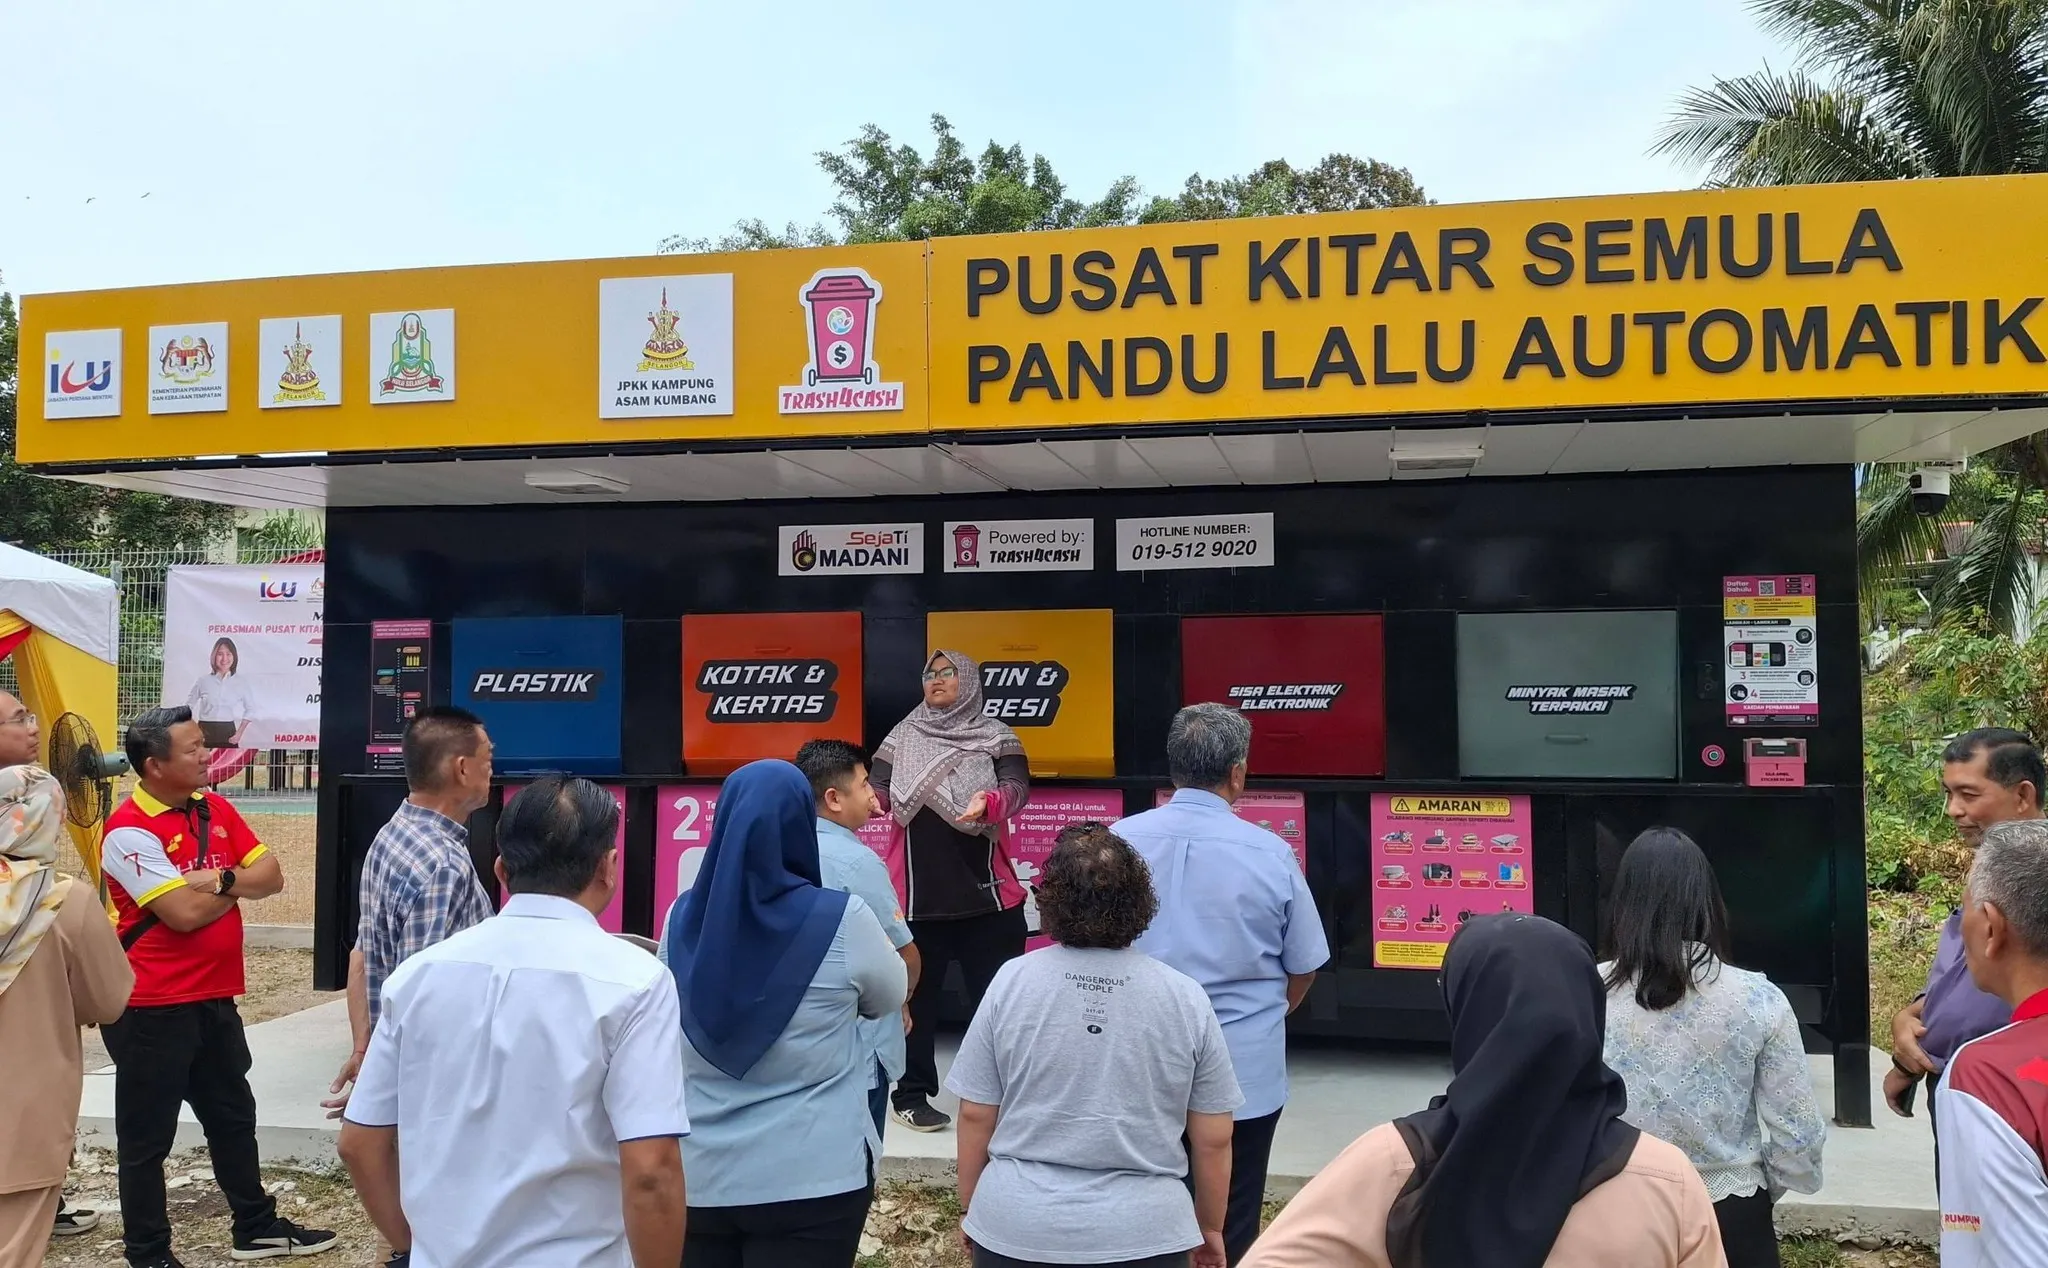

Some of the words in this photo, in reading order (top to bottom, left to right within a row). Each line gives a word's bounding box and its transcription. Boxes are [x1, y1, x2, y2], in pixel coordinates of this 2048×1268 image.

[967, 243, 1219, 317] PUSAT
[1249, 227, 1495, 301] KITAR
[1523, 208, 1903, 286] SEMULA
[967, 332, 1228, 403] PANDU
[1262, 319, 1475, 390] LALU
[1503, 297, 2047, 379] AUTOMATIK
[647, 361, 684, 369] SELANGOR
[617, 380, 648, 391] JPKK
[651, 378, 714, 390] KAMPUNG
[615, 396, 650, 407] ASAM
[654, 394, 717, 406] KUMBANG
[783, 387, 899, 410] TRASH4CASH
[1140, 526, 1190, 538] HOTLINE
[1193, 523, 1251, 535] NUMBER:
[989, 530, 1056, 544] Powered
[1061, 530, 1085, 546] by:
[989, 548, 1081, 563] TRASH4CASH
[1132, 541, 1206, 560] 019-512
[1211, 539, 1257, 557] 9020
[820, 548, 909, 567] MADANI
[208, 624, 262, 634] PERASMIAN
[265, 624, 296, 634] PUSAT
[1738, 629, 1743, 639] 1
[1788, 645, 1794, 653] 2
[702, 665, 799, 686] KOTAK
[804, 668, 826, 684] &
[984, 667, 1030, 686] TIN
[1036, 667, 1059, 686] &
[1740, 671, 1746, 680] 3
[474, 674, 594, 693] PLASTIK
[1229, 686, 1264, 697] SISA
[1266, 684, 1342, 696] ELEKTRIK/
[1507, 687, 1571, 699] MINYAK
[1572, 686, 1632, 698] MASAK
[1750, 689, 1758, 698] 4
[712, 694, 825, 715] KERTAS
[982, 698, 1050, 718] BESI
[1240, 698, 1331, 710] ELEKTRONIK
[1531, 700, 1609, 712] TERPAKAI
[274, 733, 317, 743] HADAPAN
[1059, 803, 1071, 811] QR
[1072, 803, 1083, 811] (A)
[1418, 800, 1481, 812] AMARAN
[673, 796, 700, 840] 2
[1020, 813, 1057, 822] dapatkan
[1027, 823, 1054, 832] tampal
[1065, 972, 1125, 987] DANGEROUS
[1077, 982, 1114, 993] PEOPLE
[1944, 1214, 1980, 1225] RUMPUN
